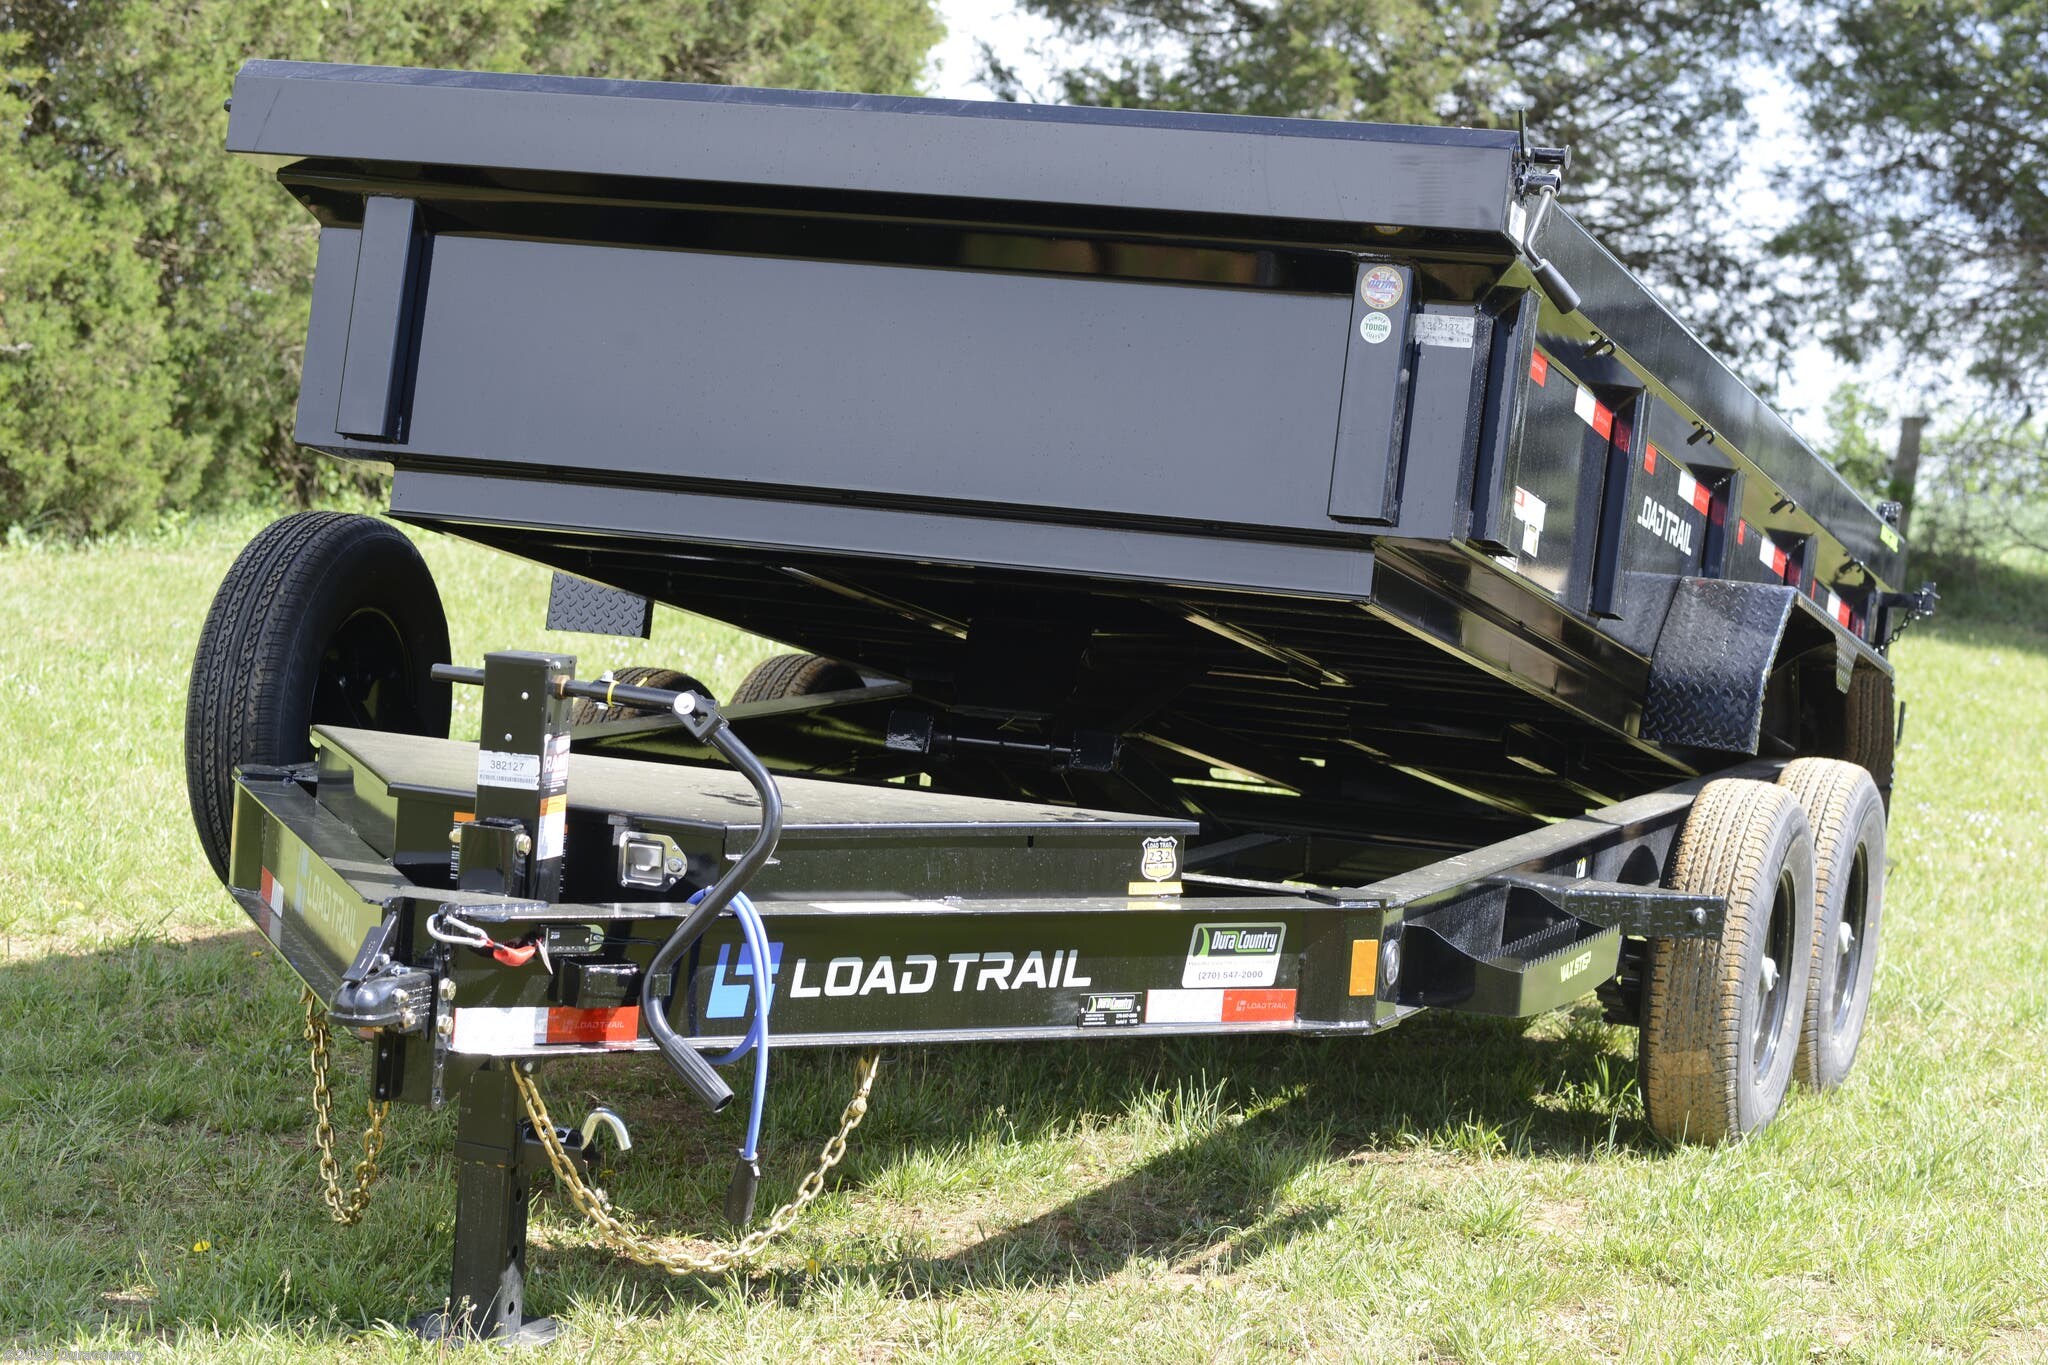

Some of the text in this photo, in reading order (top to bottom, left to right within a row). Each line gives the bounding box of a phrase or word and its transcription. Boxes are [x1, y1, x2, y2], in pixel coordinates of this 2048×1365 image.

[1365, 323, 1388, 332] TOUGH
[1665, 509, 1692, 557] TRAIL
[490, 760, 525, 771] 382127
[307, 870, 358, 948] LOAD TRAIL
[789, 953, 938, 999] LOAD
[947, 949, 1093, 992] TRAIL
[1198, 970, 1264, 980] (270) 547-2000
